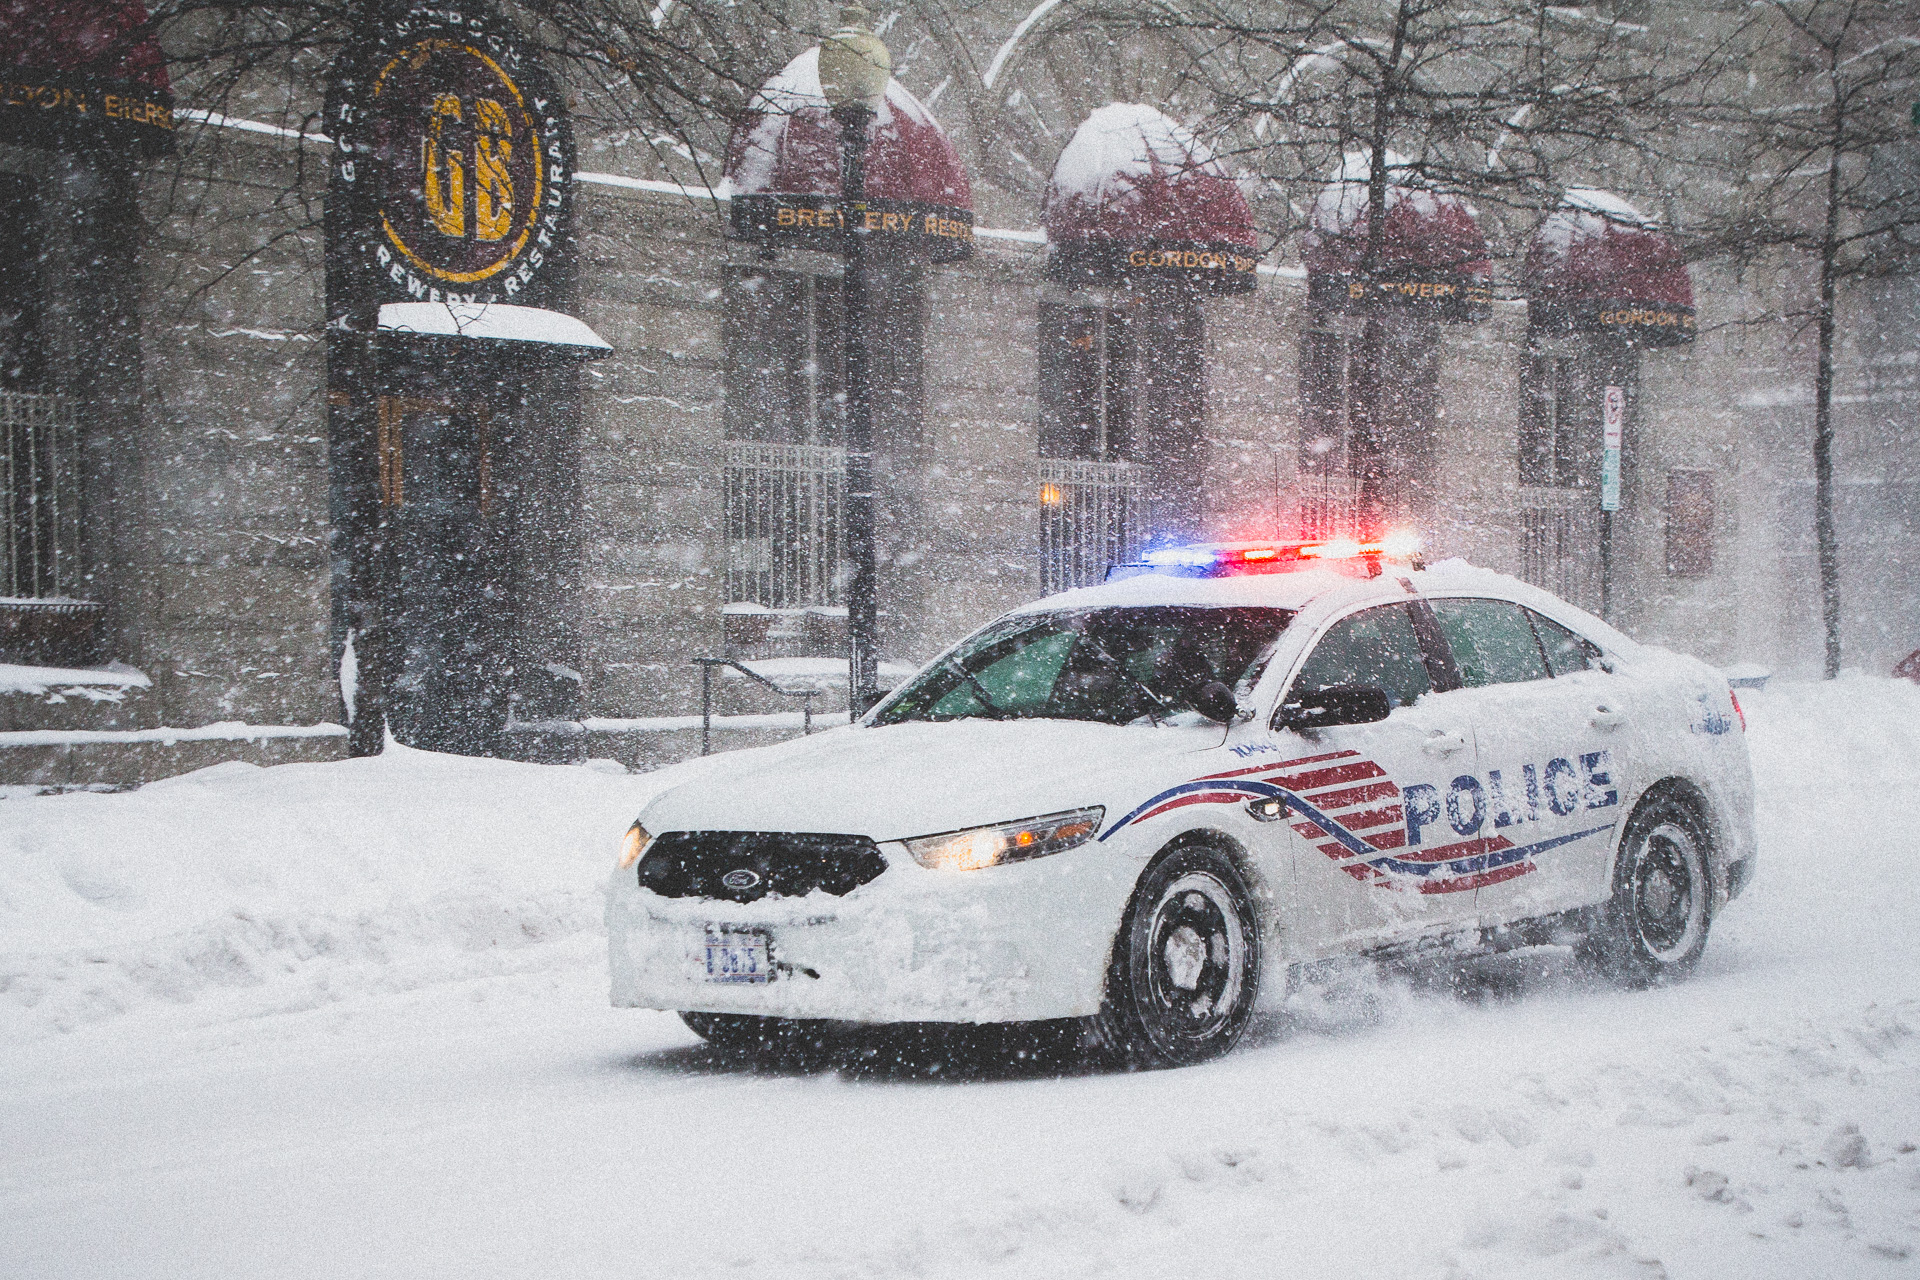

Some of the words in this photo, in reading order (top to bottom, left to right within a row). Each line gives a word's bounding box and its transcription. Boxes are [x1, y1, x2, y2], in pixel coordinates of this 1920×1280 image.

[0, 82, 87, 113] DON
[777, 207, 913, 232] BREERY
[362, 243, 477, 304] REWERY
[1129, 250, 1226, 270] GORDON
[1349, 282, 1457, 299] BEWERY
[1402, 750, 1618, 847] POLICE
